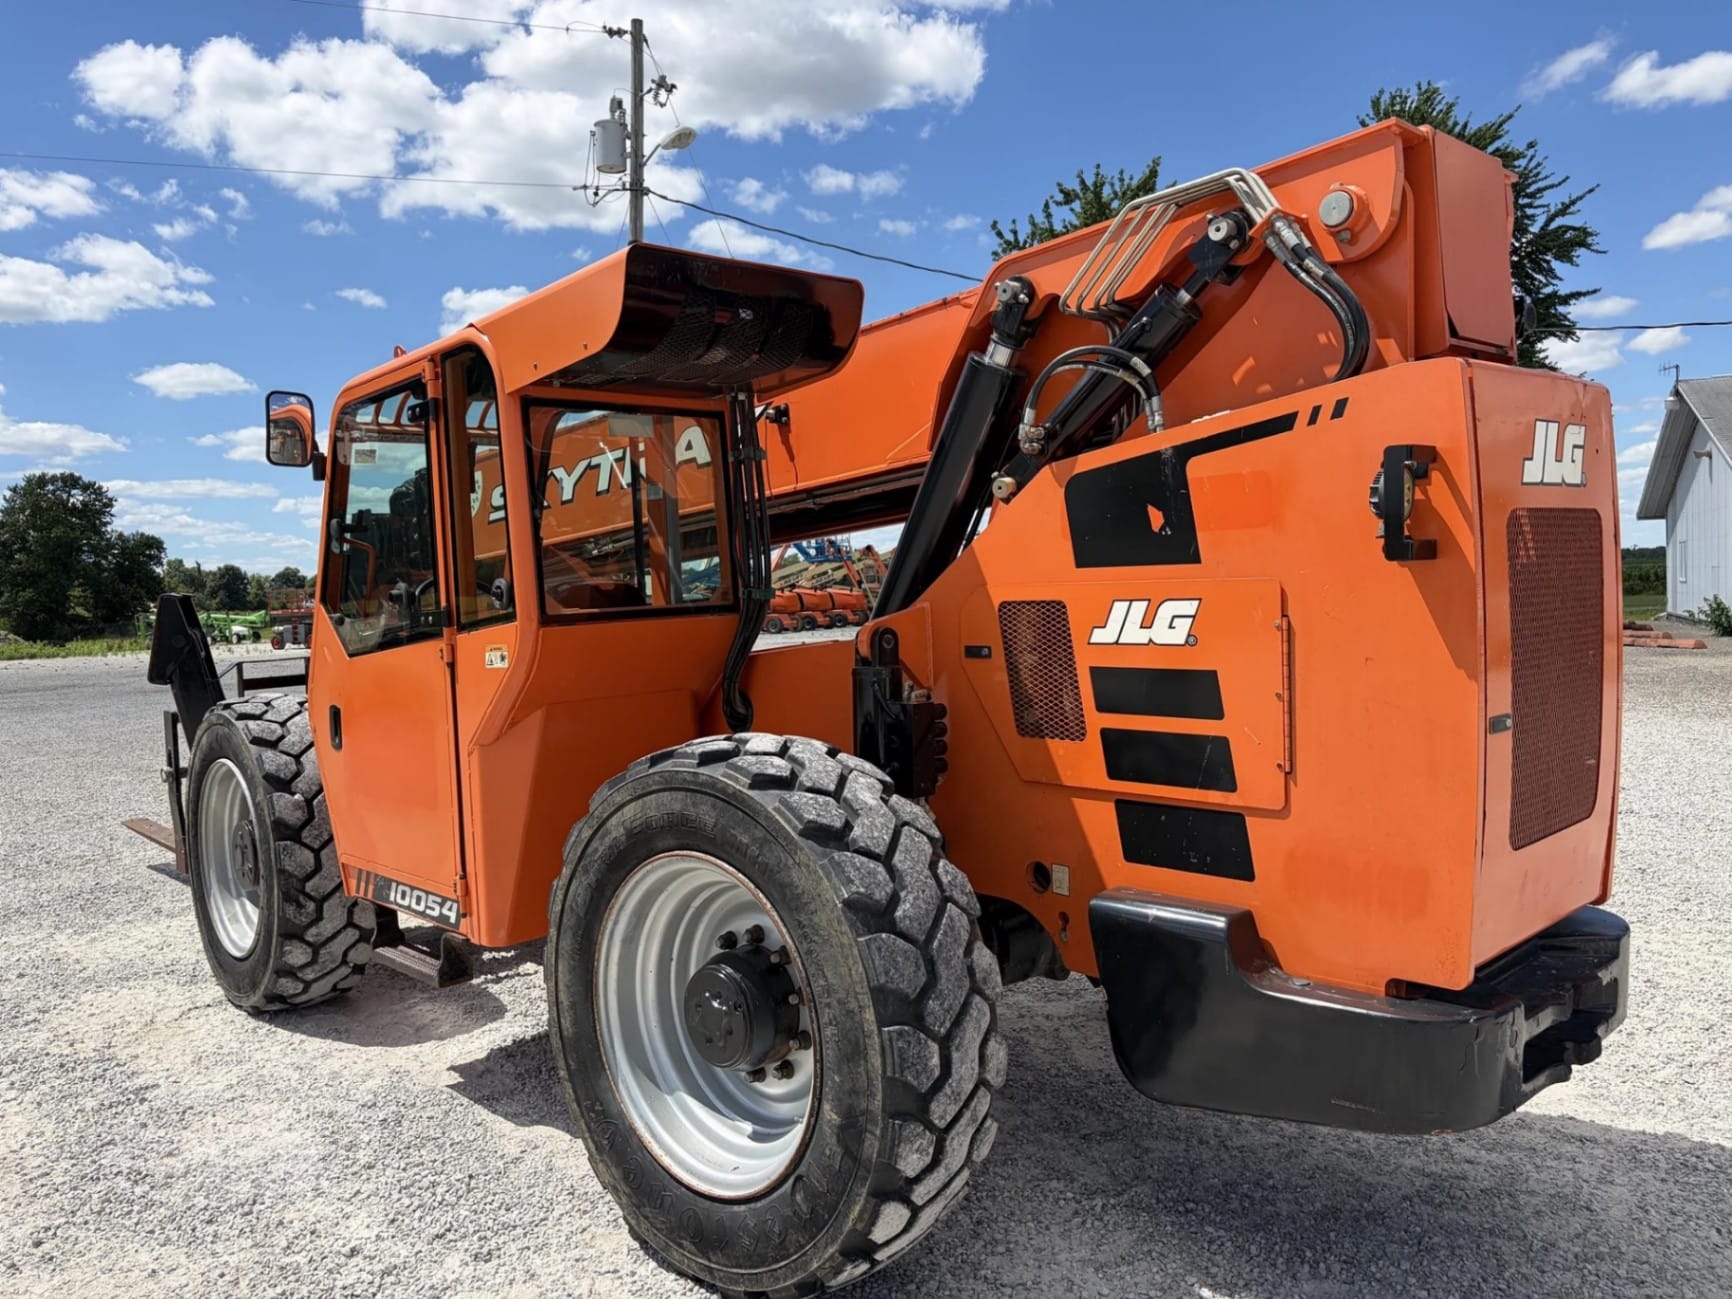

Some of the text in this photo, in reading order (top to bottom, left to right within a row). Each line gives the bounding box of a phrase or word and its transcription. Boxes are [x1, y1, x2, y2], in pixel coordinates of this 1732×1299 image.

[1521, 418, 1586, 487] JLG
[1088, 598, 1202, 646] JLG
[388, 880, 459, 925] 10054
